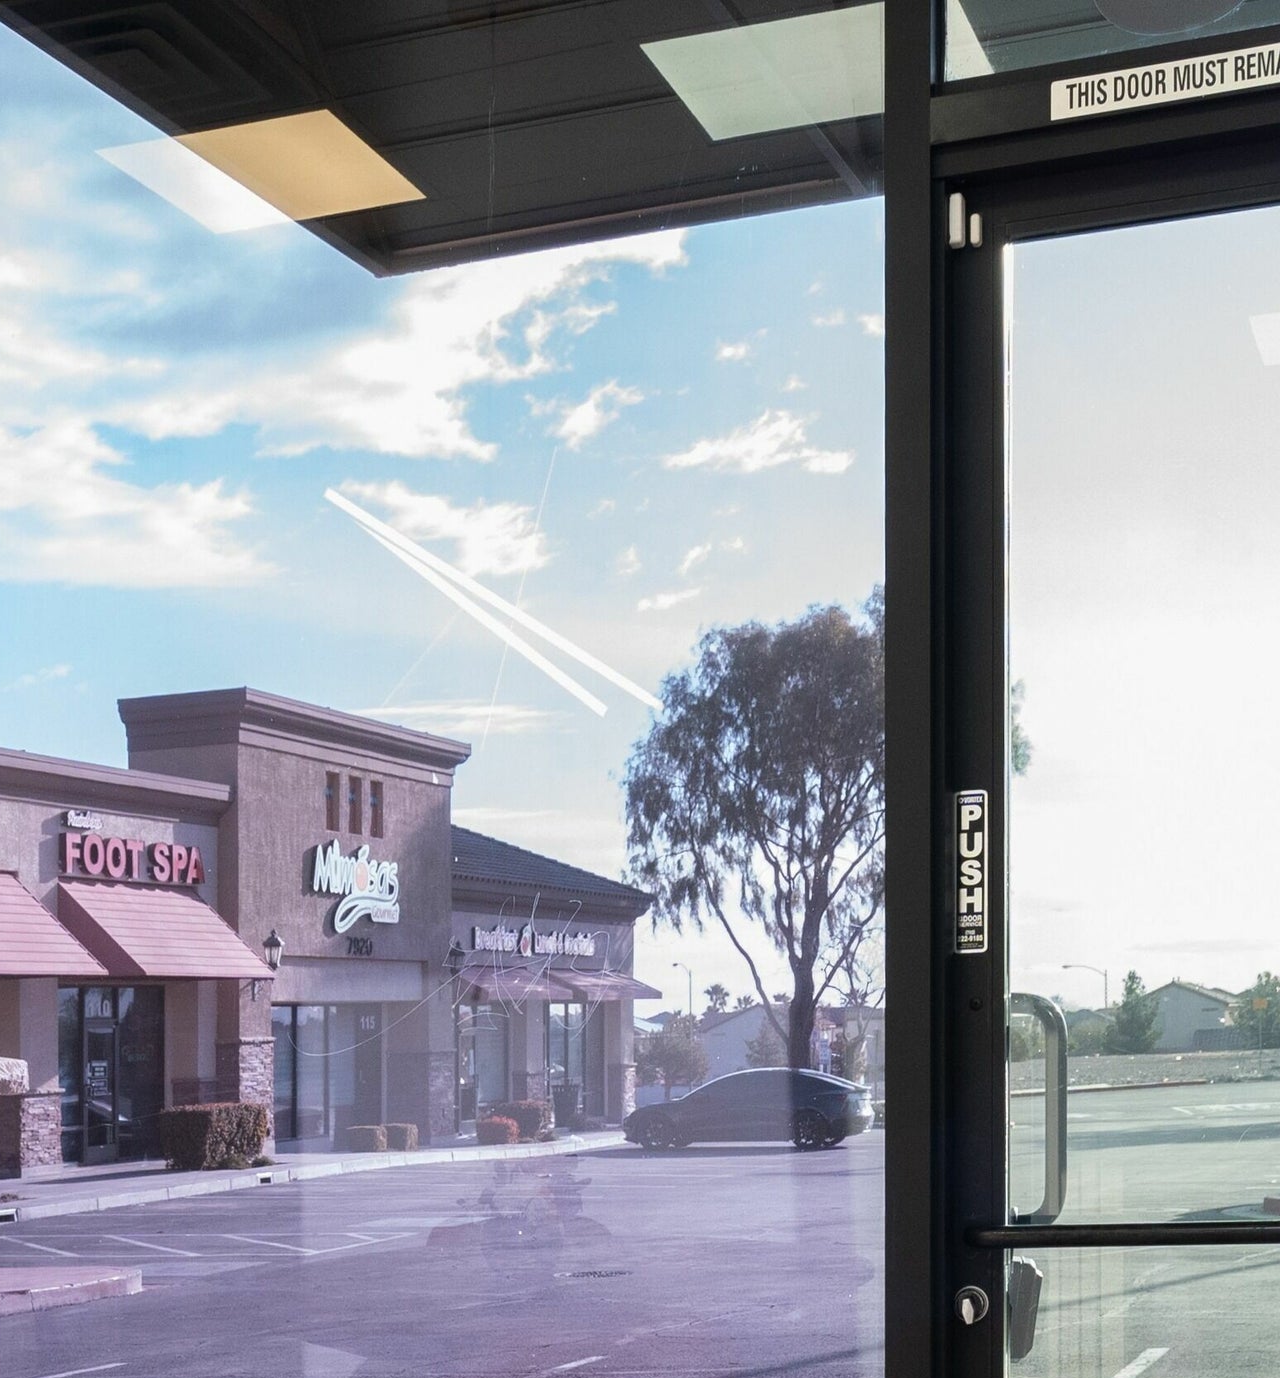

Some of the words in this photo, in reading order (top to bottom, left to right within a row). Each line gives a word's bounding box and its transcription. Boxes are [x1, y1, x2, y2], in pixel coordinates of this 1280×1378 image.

[1065, 79, 1108, 110] THIS
[1113, 69, 1167, 103] DOOR
[1173, 58, 1228, 93] MUST
[64, 831, 145, 880] FOOT
[152, 841, 205, 885] SPA
[959, 805, 983, 914] PUSH
[346, 937, 374, 957] 7920
[360, 1015, 376, 1030] 115
